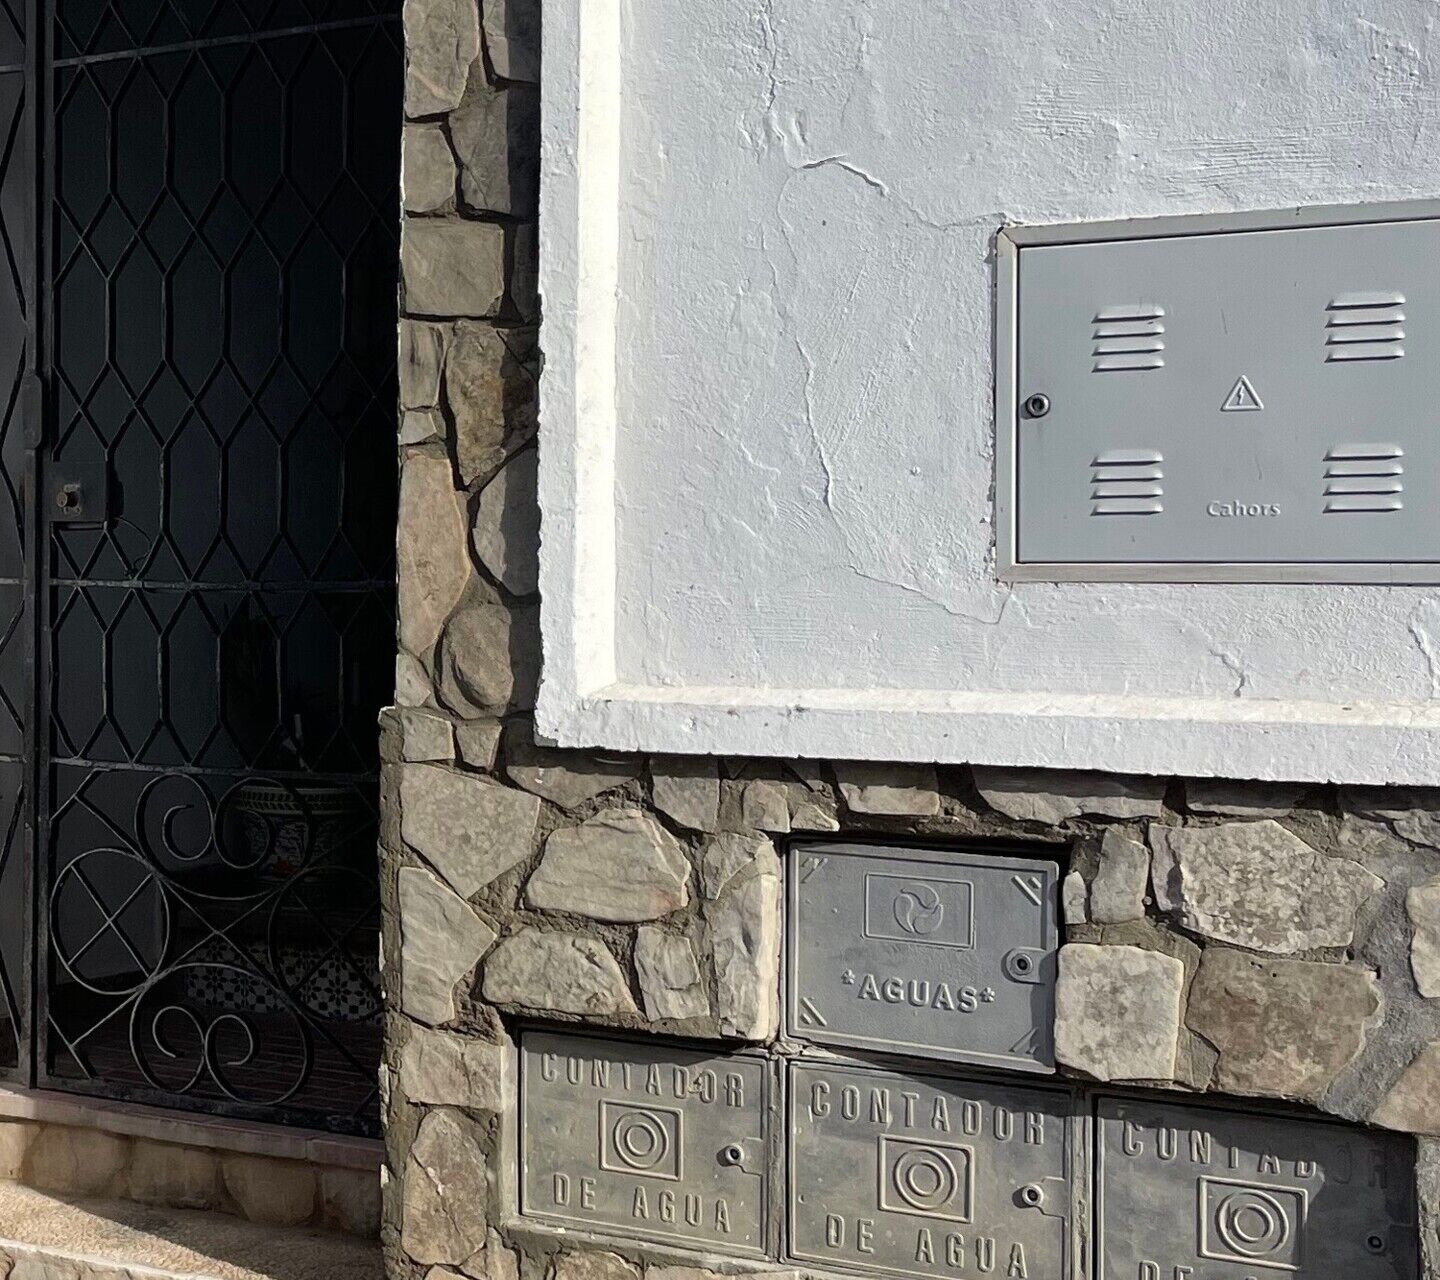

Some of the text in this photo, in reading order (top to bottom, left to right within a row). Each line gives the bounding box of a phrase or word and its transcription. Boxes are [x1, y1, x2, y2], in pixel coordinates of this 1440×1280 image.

[1206, 499, 1281, 517] Cahors
[541, 1052, 745, 1108] CONTADOR
[811, 1080, 1045, 1145] CONTADOR
[553, 1172, 732, 1233] DE AGUA
[826, 1214, 1029, 1279] DE AGUA
